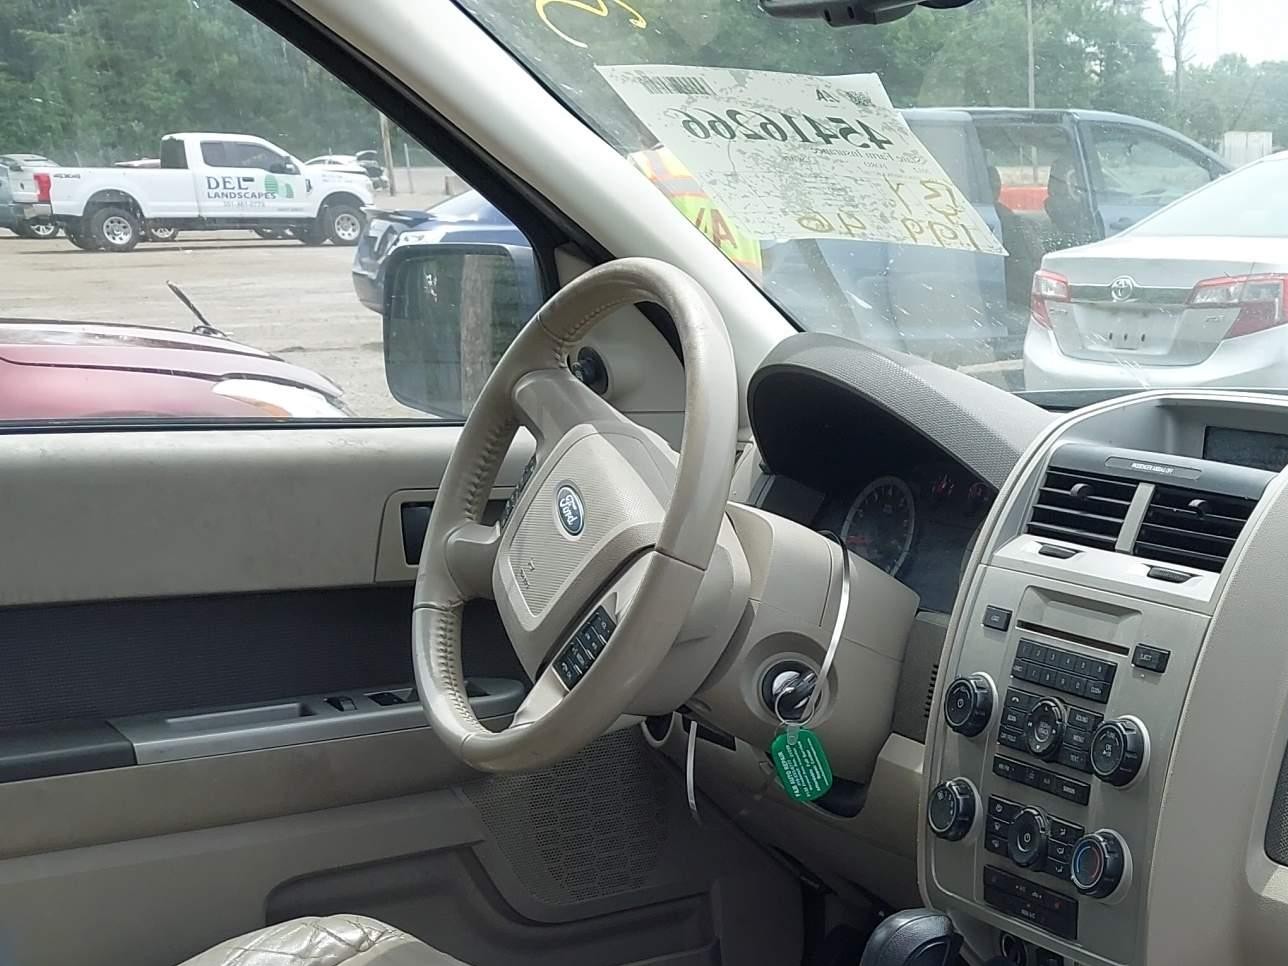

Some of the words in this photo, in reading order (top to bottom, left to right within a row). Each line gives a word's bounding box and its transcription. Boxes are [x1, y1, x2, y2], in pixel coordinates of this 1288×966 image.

[206, 176, 249, 190] DEL
[207, 191, 276, 199] LANDSCAPES
[560, 494, 578, 526] Ford
